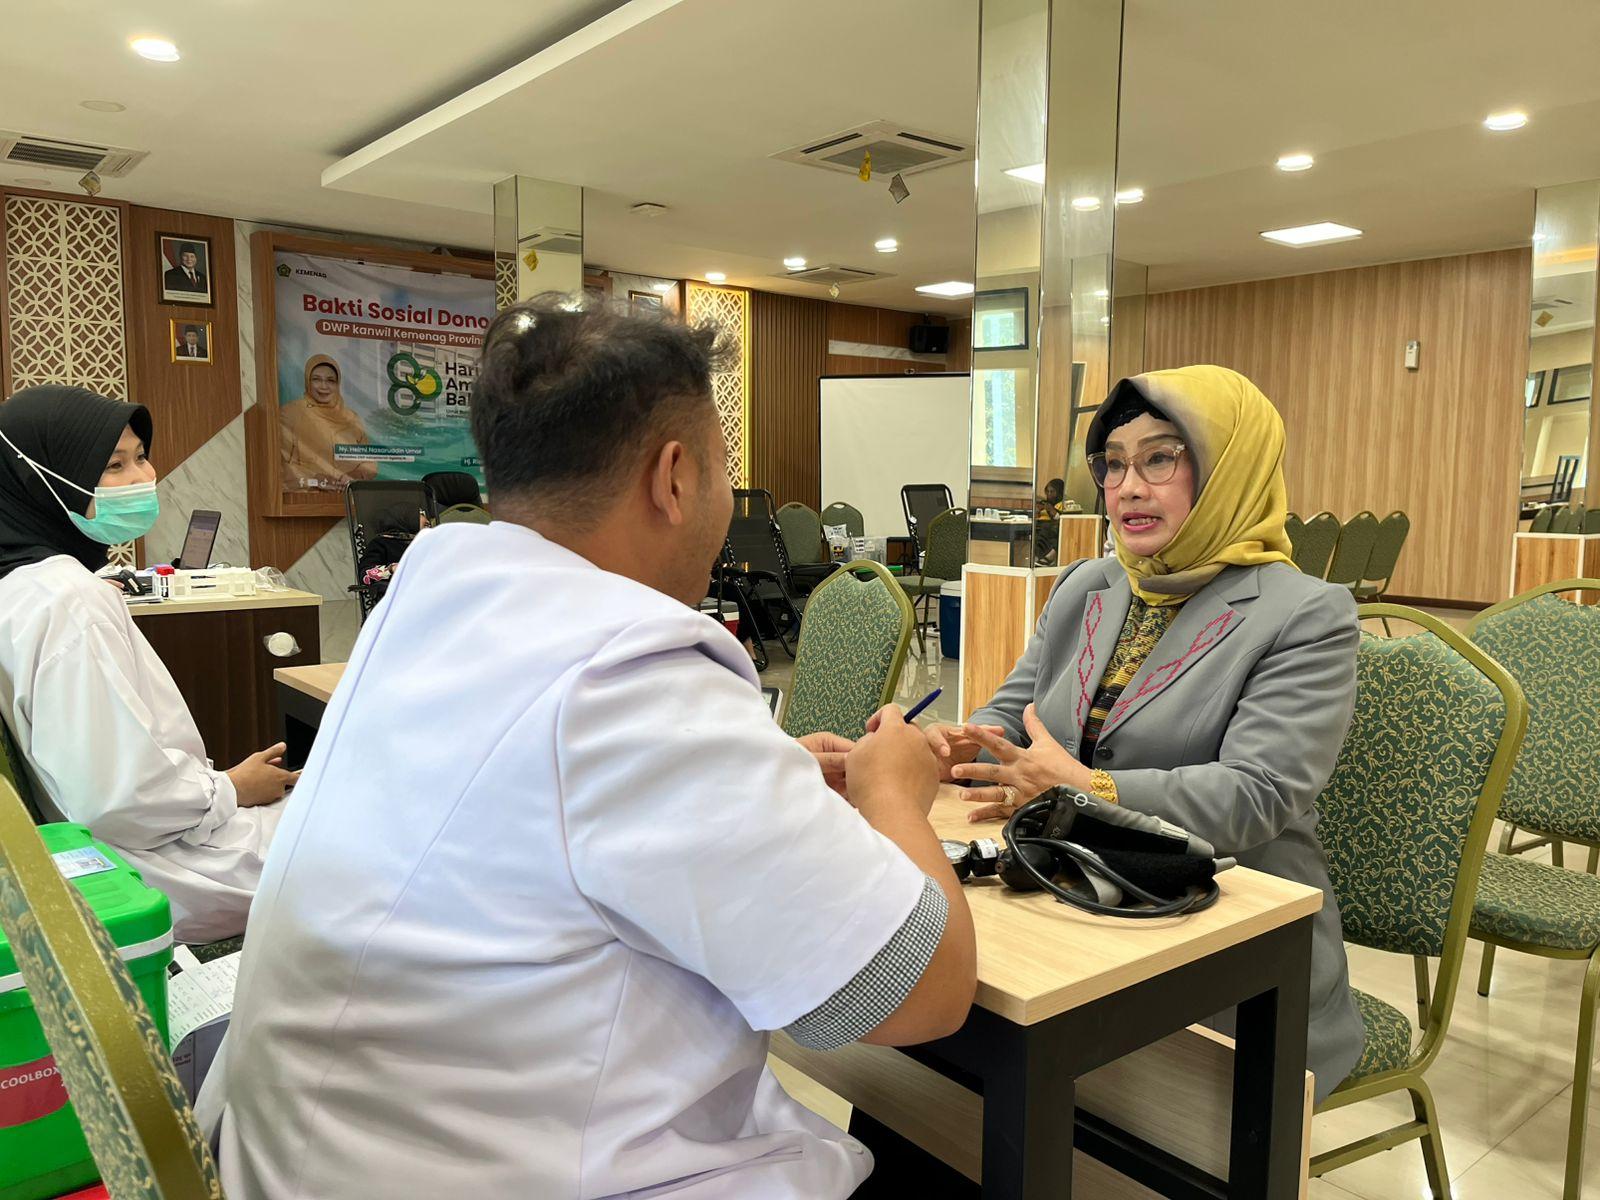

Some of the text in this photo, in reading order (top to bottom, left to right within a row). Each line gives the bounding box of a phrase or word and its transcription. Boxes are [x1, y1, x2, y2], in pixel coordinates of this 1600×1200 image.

[295, 268, 327, 279] KEMENAG
[303, 294, 489, 329] Bakti Sosial Dono
[322, 321, 350, 333] DWP
[352, 324, 391, 337] kanwil
[393, 328, 447, 345] Kemenag
[445, 361, 479, 377] Hari
[445, 377, 472, 391] Am
[0, 1066, 60, 1090] COOLBOX
